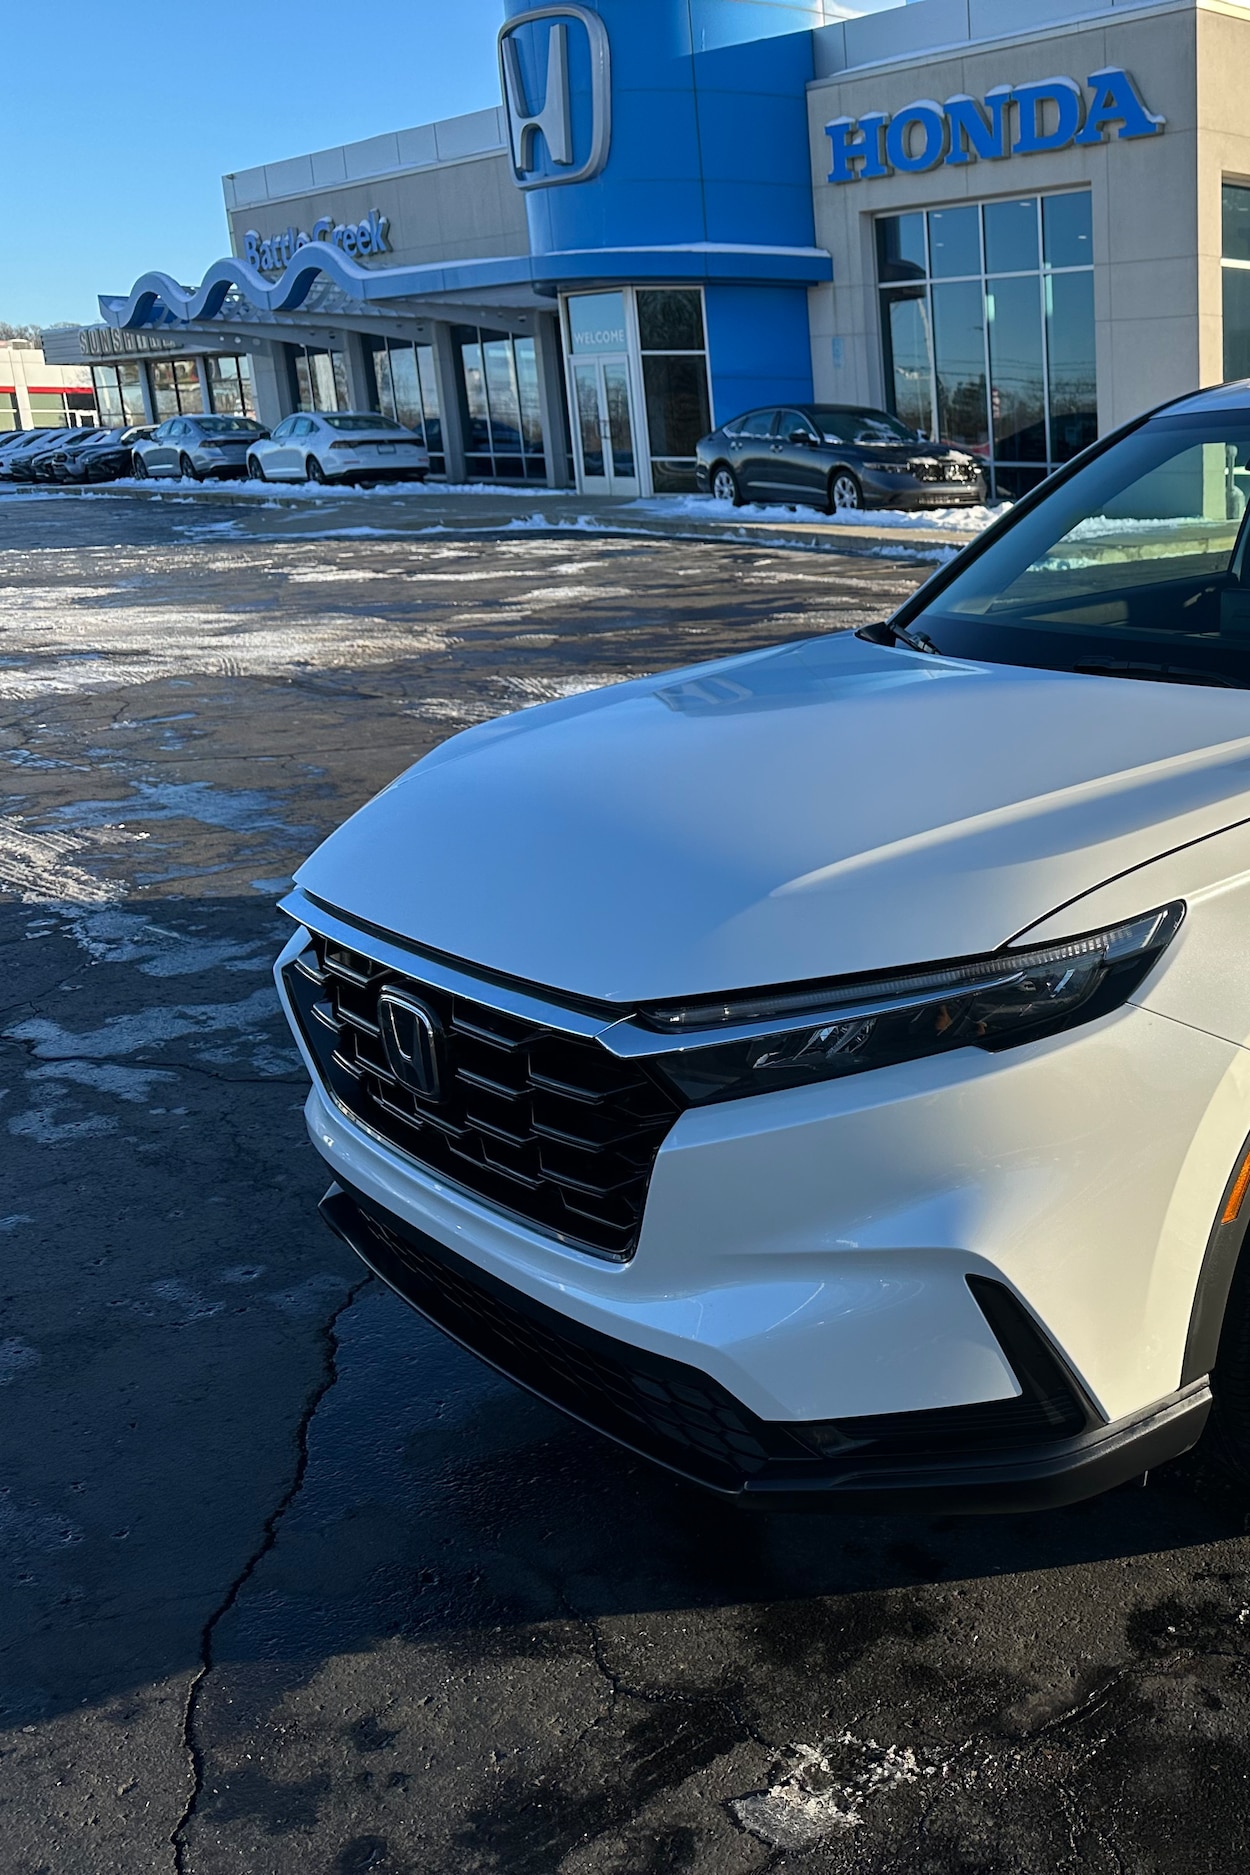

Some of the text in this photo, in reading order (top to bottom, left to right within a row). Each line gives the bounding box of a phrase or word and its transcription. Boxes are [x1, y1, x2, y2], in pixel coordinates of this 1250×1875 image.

[824, 67, 1164, 184] HONDA
[312, 208, 392, 256] Creek
[573, 329, 625, 345] WELCOME
